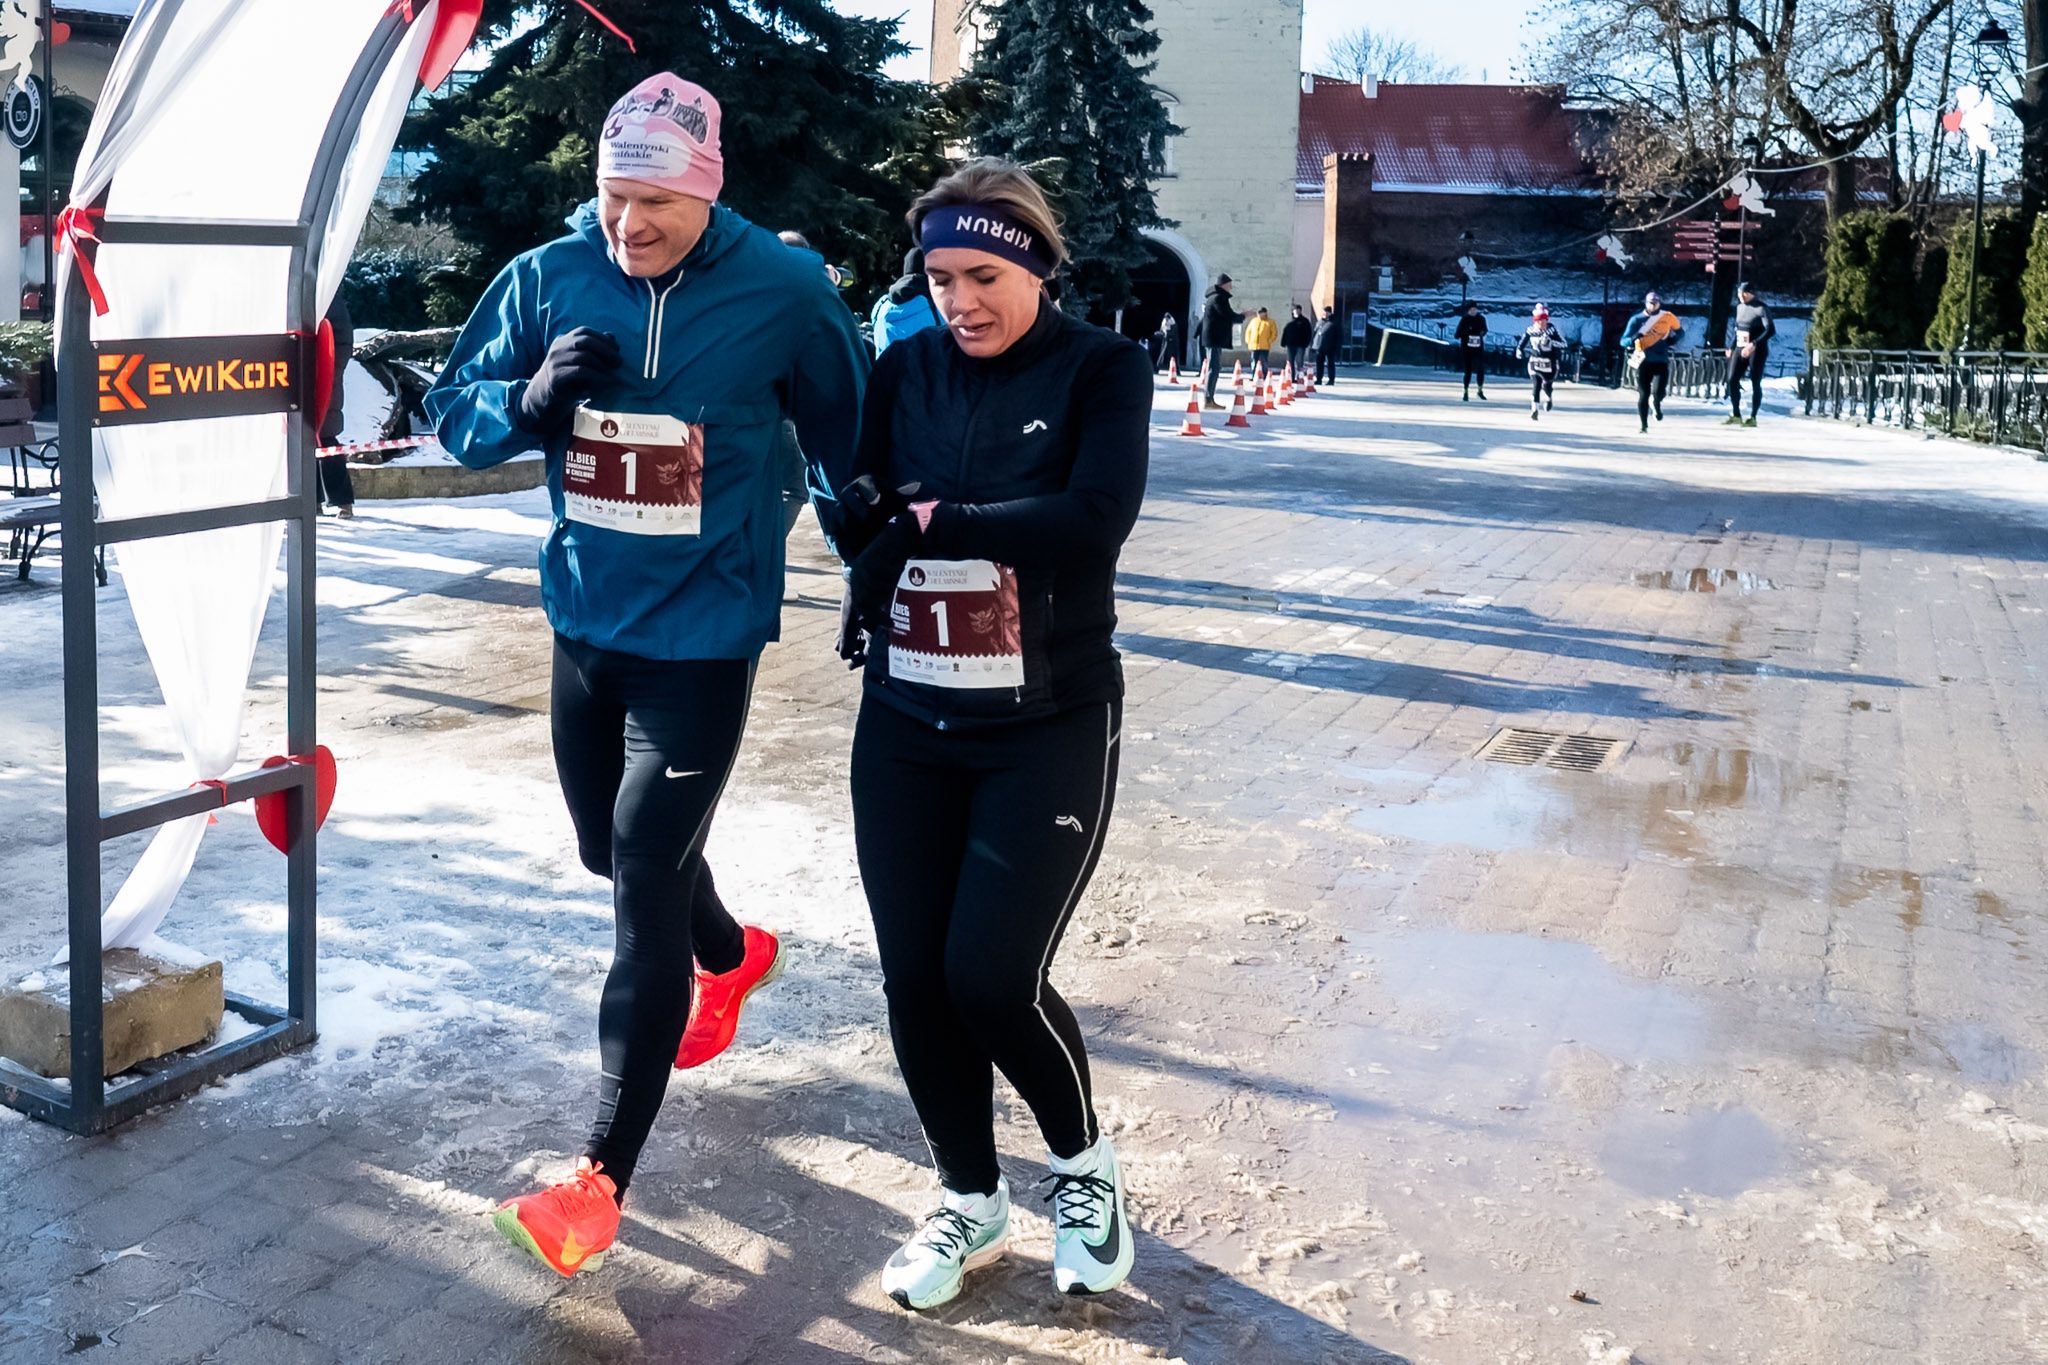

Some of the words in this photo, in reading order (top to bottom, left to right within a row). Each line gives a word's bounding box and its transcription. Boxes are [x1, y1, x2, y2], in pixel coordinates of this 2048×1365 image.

[610, 141, 669, 154] Walentynki
[956, 215, 1033, 251] KIPRUN
[620, 451, 637, 495] 1
[930, 600, 950, 647] 1
